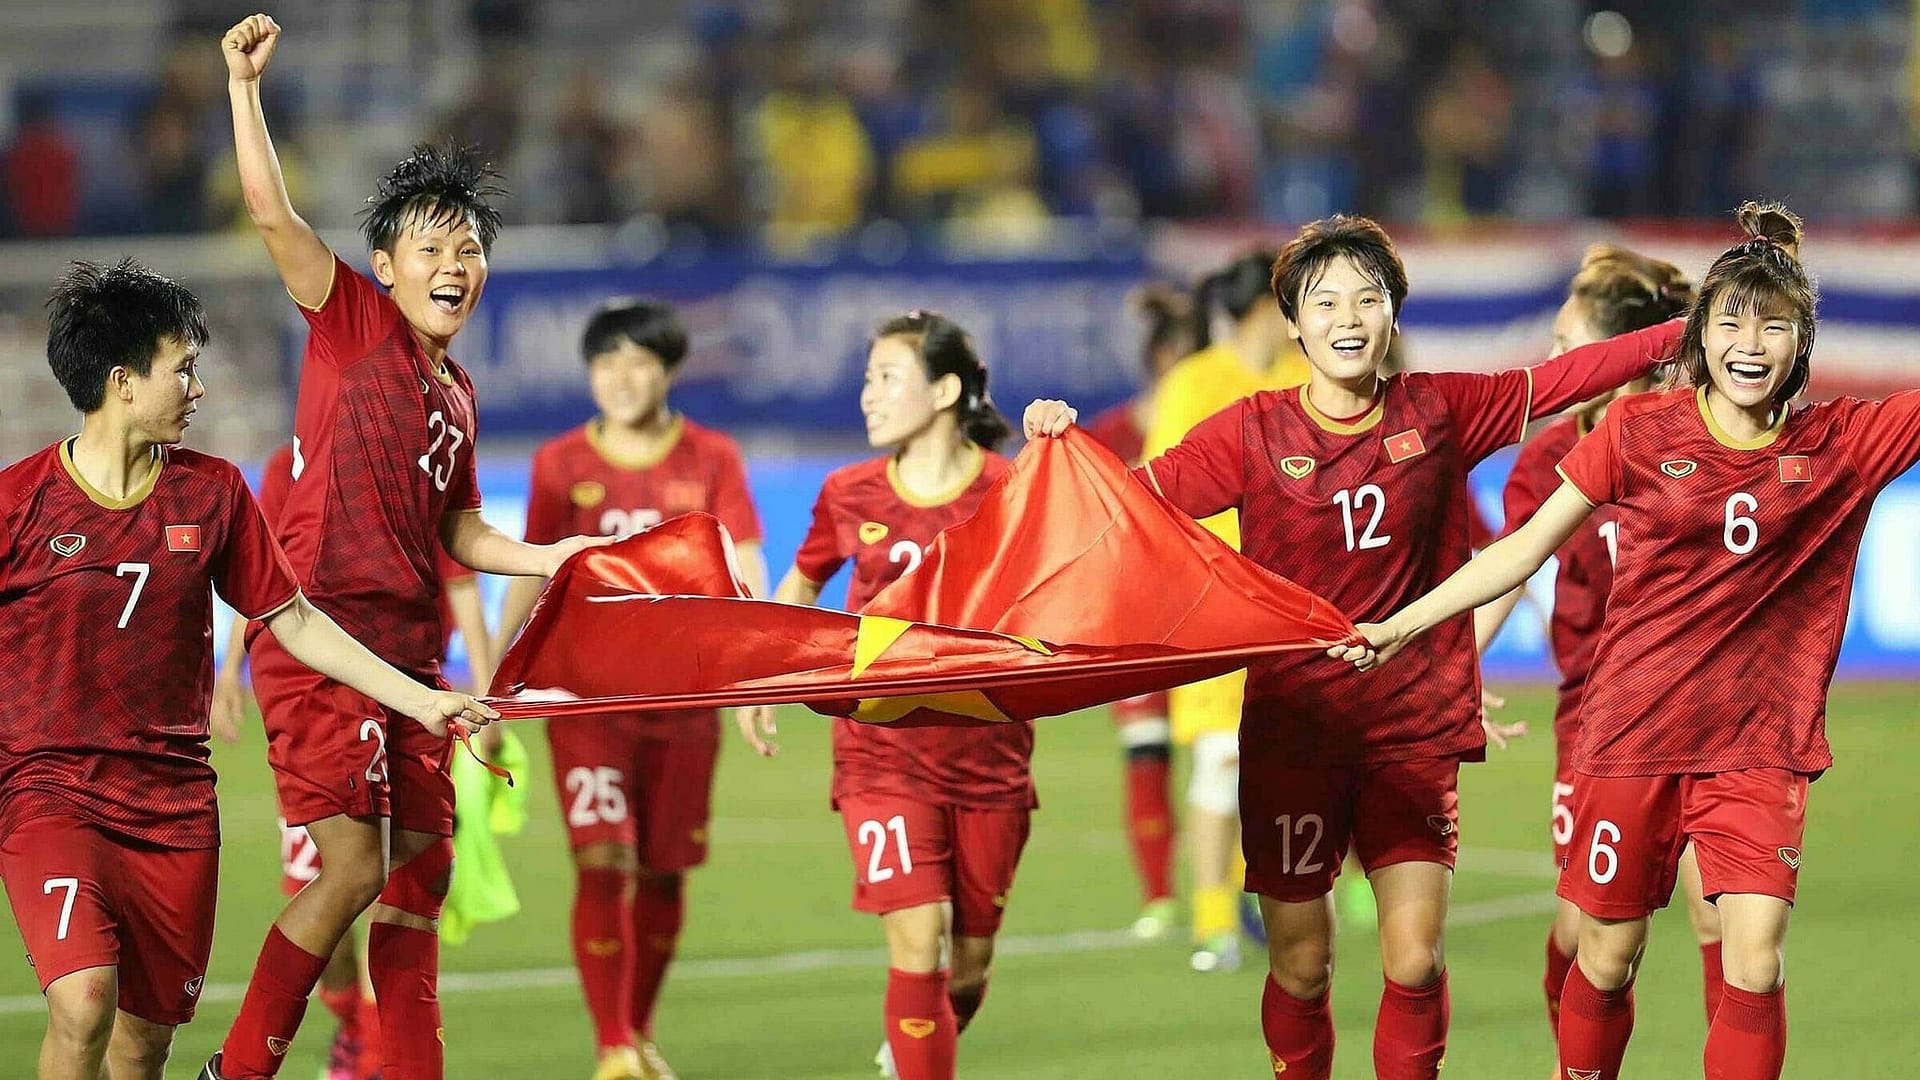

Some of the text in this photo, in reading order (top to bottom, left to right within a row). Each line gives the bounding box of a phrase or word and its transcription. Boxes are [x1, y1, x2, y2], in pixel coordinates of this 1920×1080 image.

[418, 410, 463, 491] 23
[1333, 484, 1391, 553] 12
[1723, 492, 1758, 556] 6
[888, 540, 932, 576] 2
[116, 563, 150, 629] 7
[360, 720, 387, 783] 2
[566, 767, 629, 829] 25
[858, 815, 912, 884] 21
[1275, 814, 1324, 876] 12
[1589, 820, 1621, 885] 6
[43, 877, 78, 940] 7
